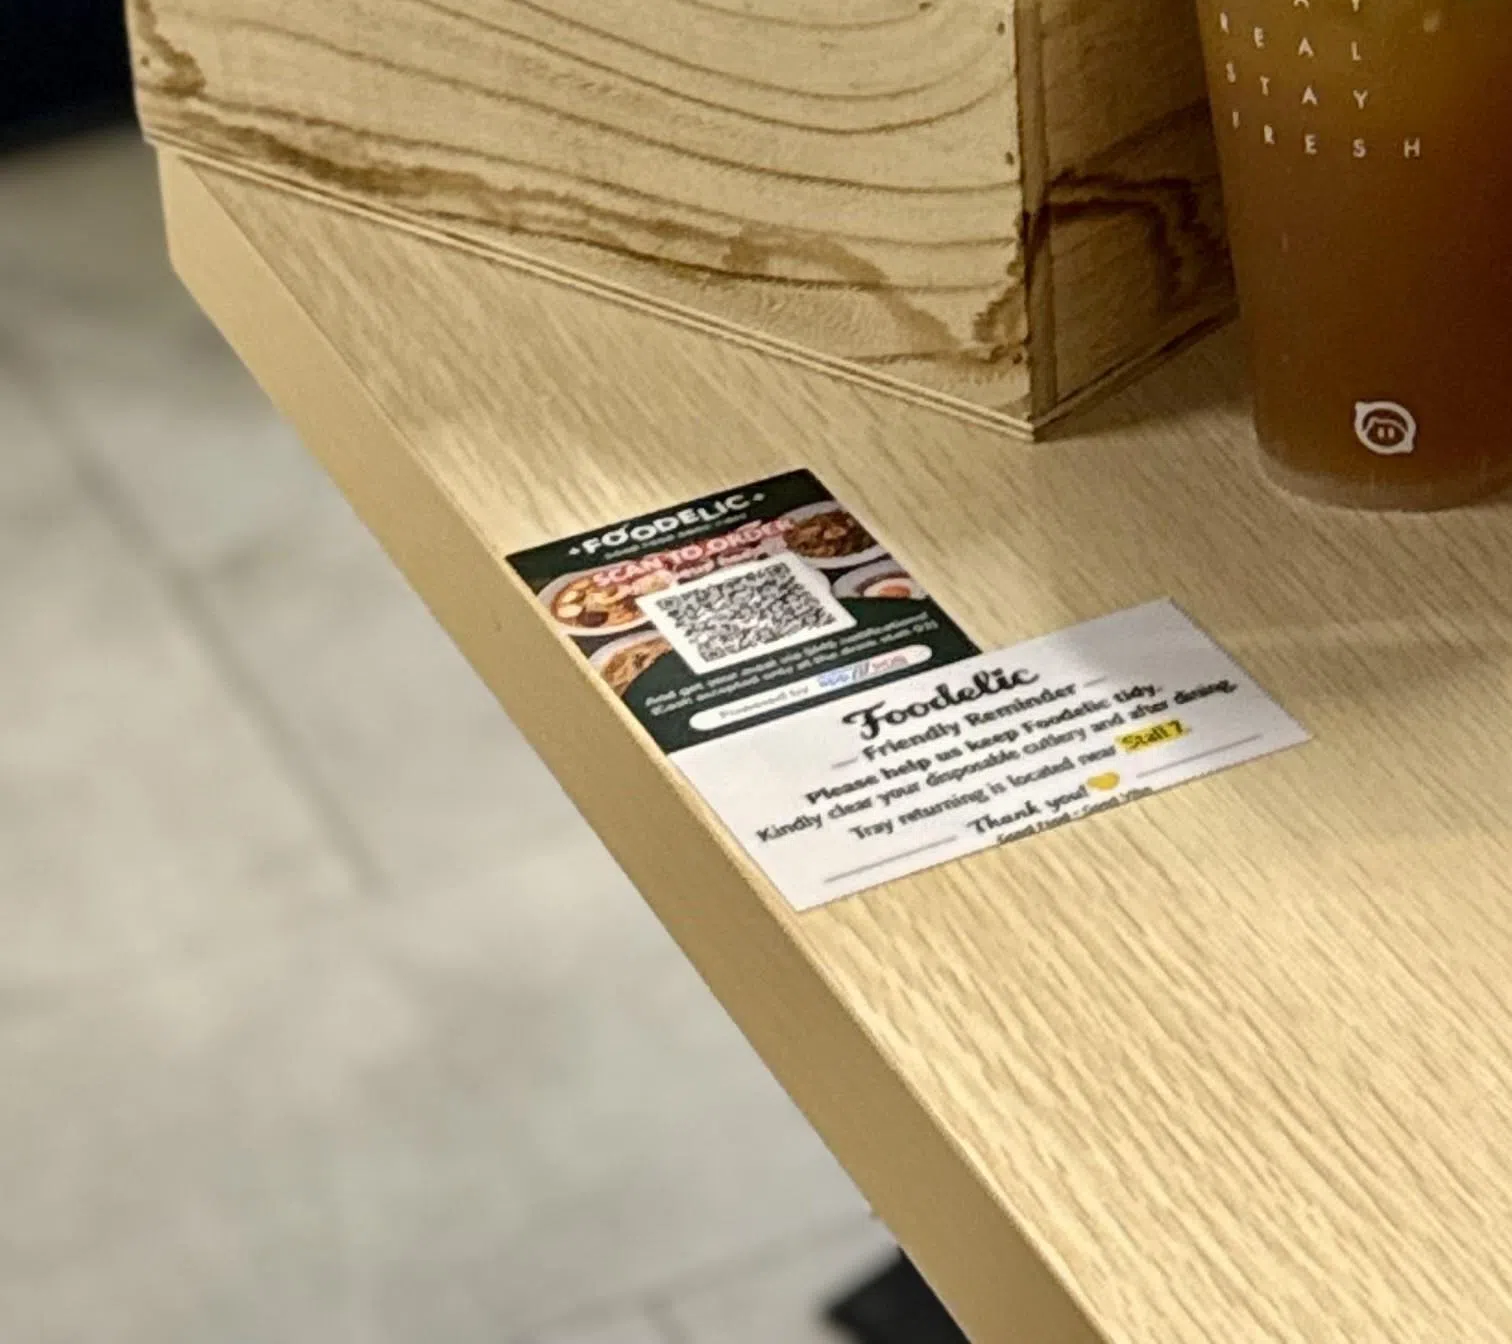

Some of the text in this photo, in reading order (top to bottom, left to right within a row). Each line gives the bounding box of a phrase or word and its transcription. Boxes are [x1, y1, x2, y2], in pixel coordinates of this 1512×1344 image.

[582, 492, 750, 555] FOODELIC
[842, 666, 1040, 740] Foodelic
[862, 683, 1077, 761] Friendly Reminder
[756, 814, 823, 842] Kindly
[827, 796, 873, 819] clear
[875, 780, 921, 806] your
[926, 748, 1021, 788] disposable
[1022, 726, 1087, 755] cutlery
[1090, 711, 1126, 733] and
[805, 774, 881, 805] Please
[880, 757, 932, 780] help
[934, 746, 964, 762] us
[965, 728, 1020, 752] keep
[1021, 697, 1111, 734] Foodelic
[848, 818, 894, 840] Tray
[898, 789, 990, 826] returning
[987, 781, 1007, 795] is
[1006, 755, 1075, 788] located
[1077, 745, 1117, 766] near
[1121, 723, 1170, 750] Stall
[967, 784, 1090, 834] Thank you!
